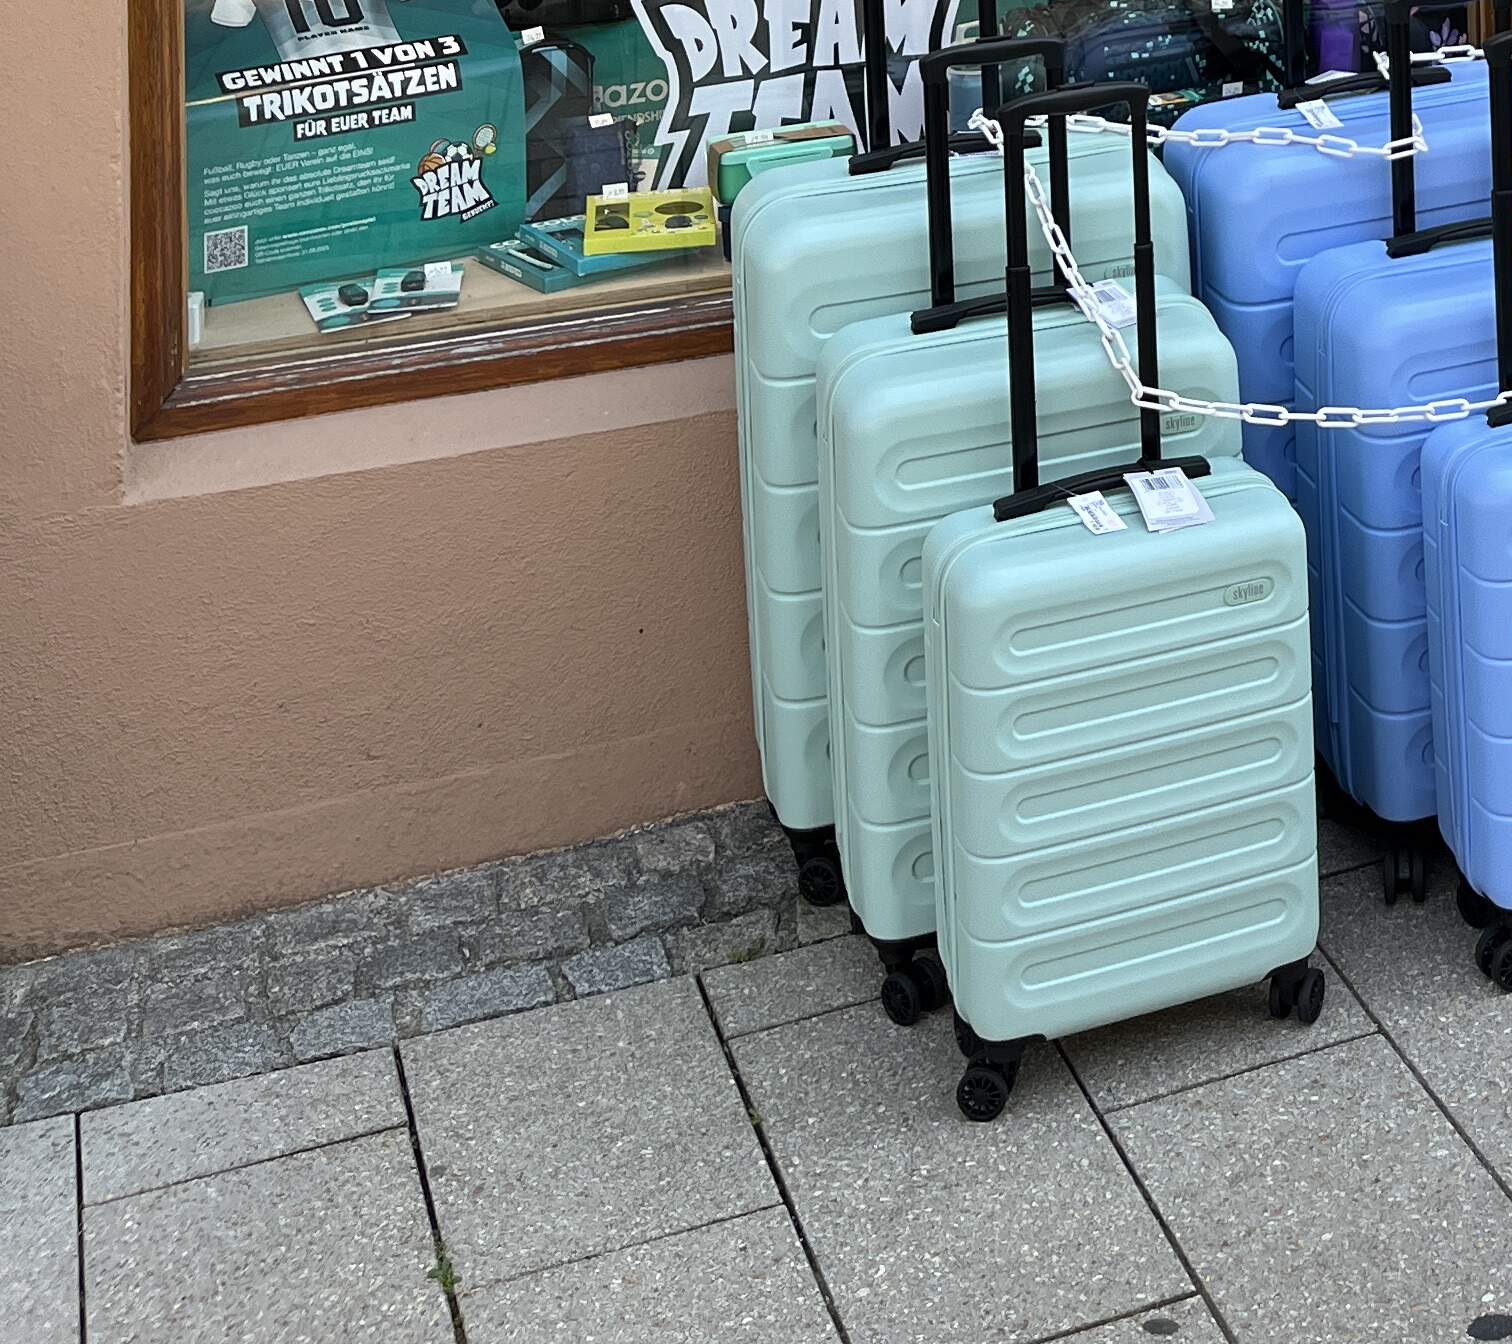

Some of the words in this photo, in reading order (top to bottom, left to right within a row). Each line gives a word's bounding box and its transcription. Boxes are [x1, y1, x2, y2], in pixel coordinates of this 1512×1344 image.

[340, 25, 370, 35] NAME
[222, 54, 345, 91] GEWINNT
[350, 51, 370, 69] 1
[371, 40, 435, 64] VON
[438, 35, 461, 55] 3
[242, 62, 459, 122] TRIKOTSÄTZEN
[296, 118, 328, 139] FÜR
[331, 112, 370, 133] EUER
[372, 105, 413, 125] TEAM
[413, 159, 481, 196] DREAM
[422, 179, 490, 219] TEAM
[1165, 414, 1196, 431] skyline
[1232, 581, 1265, 602] skyline
